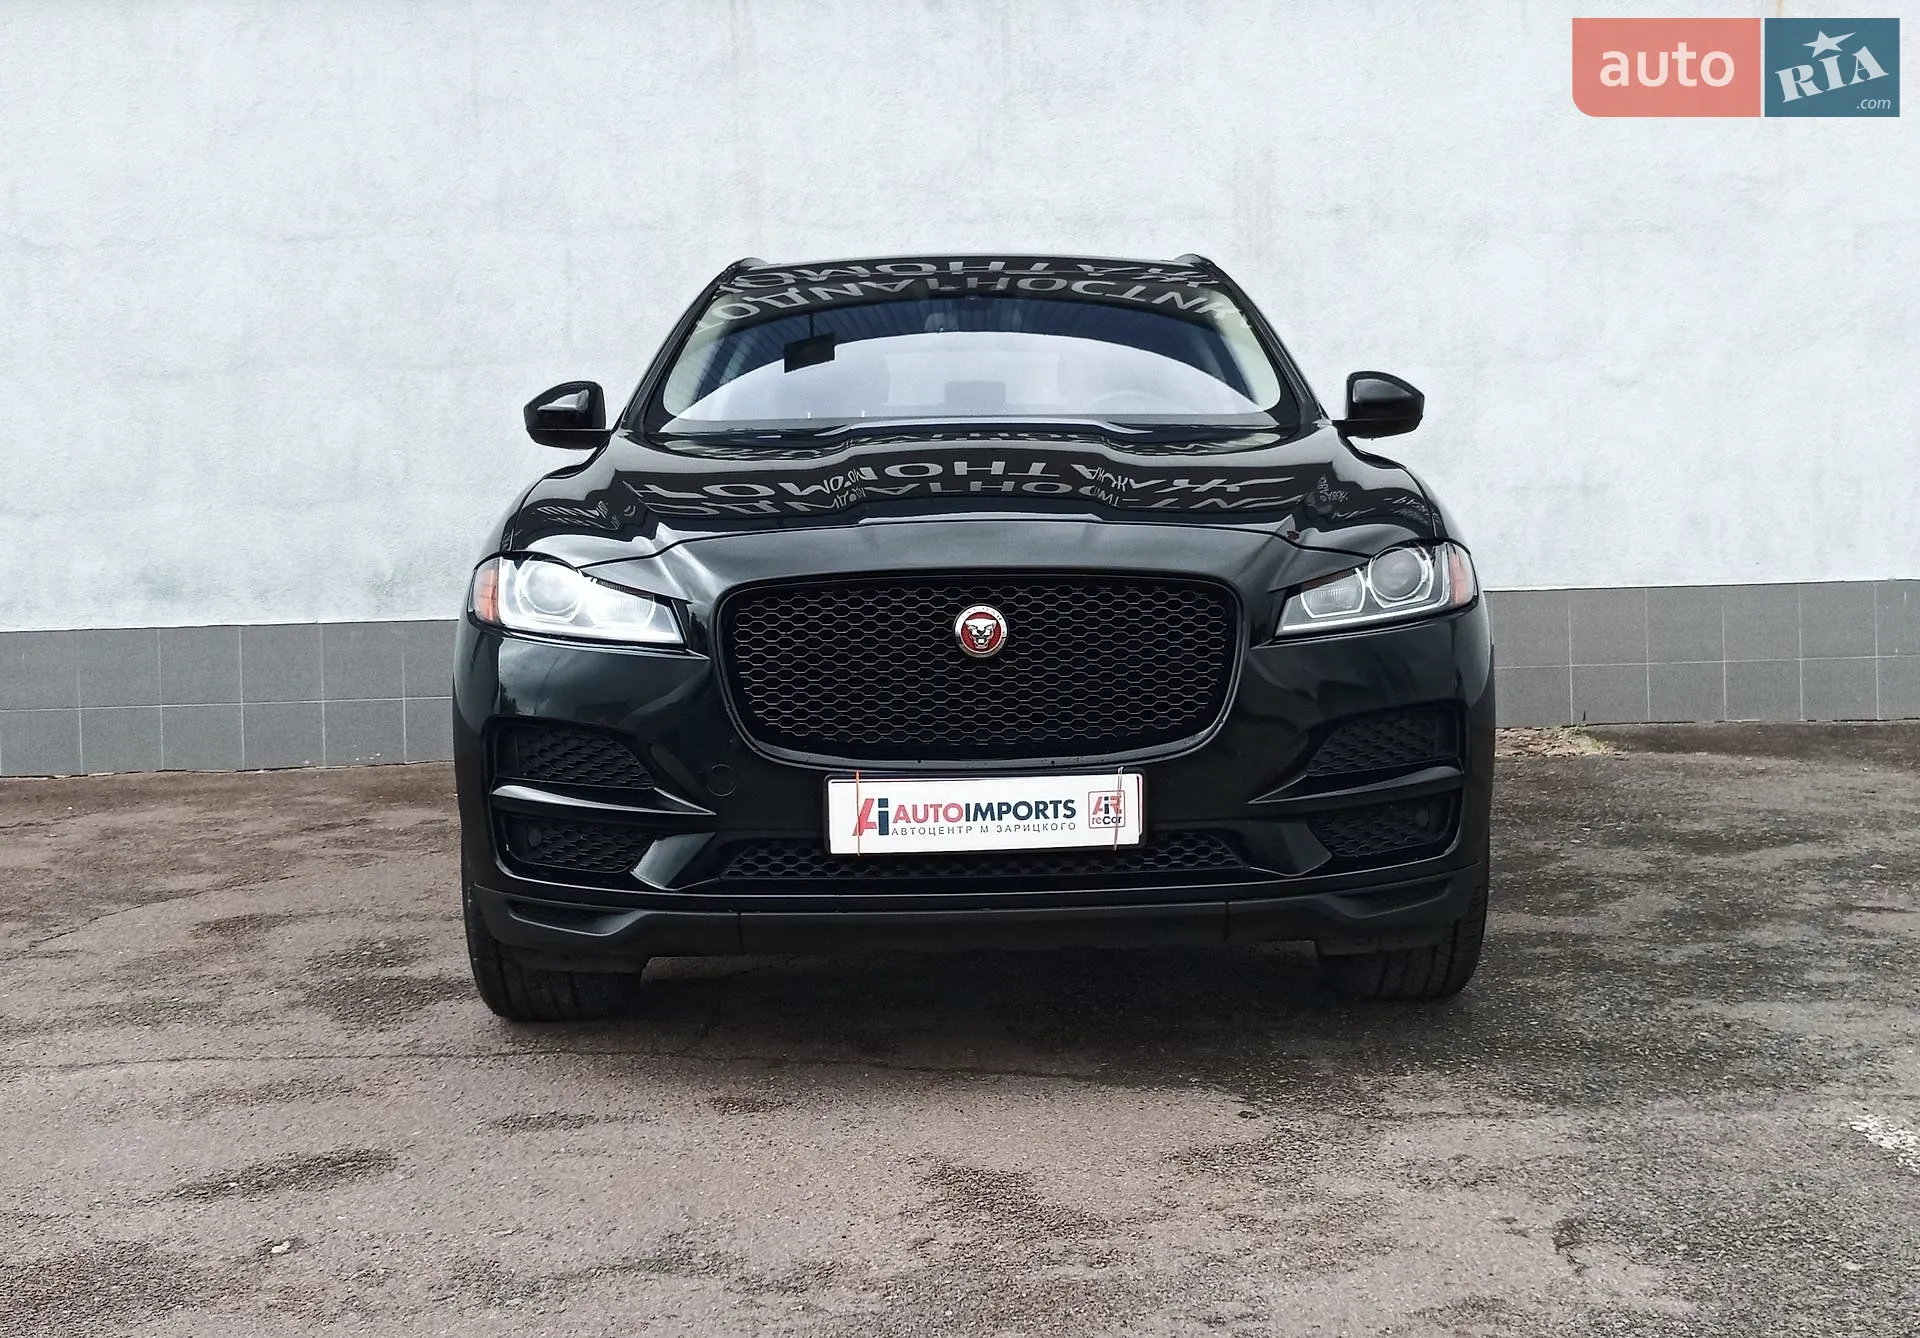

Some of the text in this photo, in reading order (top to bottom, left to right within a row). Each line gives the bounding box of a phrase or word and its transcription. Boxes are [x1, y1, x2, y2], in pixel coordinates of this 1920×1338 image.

[893, 799, 1077, 824] AUTOIMPORTS
[891, 825, 973, 837] АВТОЦЕНТР
[996, 822, 1077, 834] ЗАРИЦКОГО
